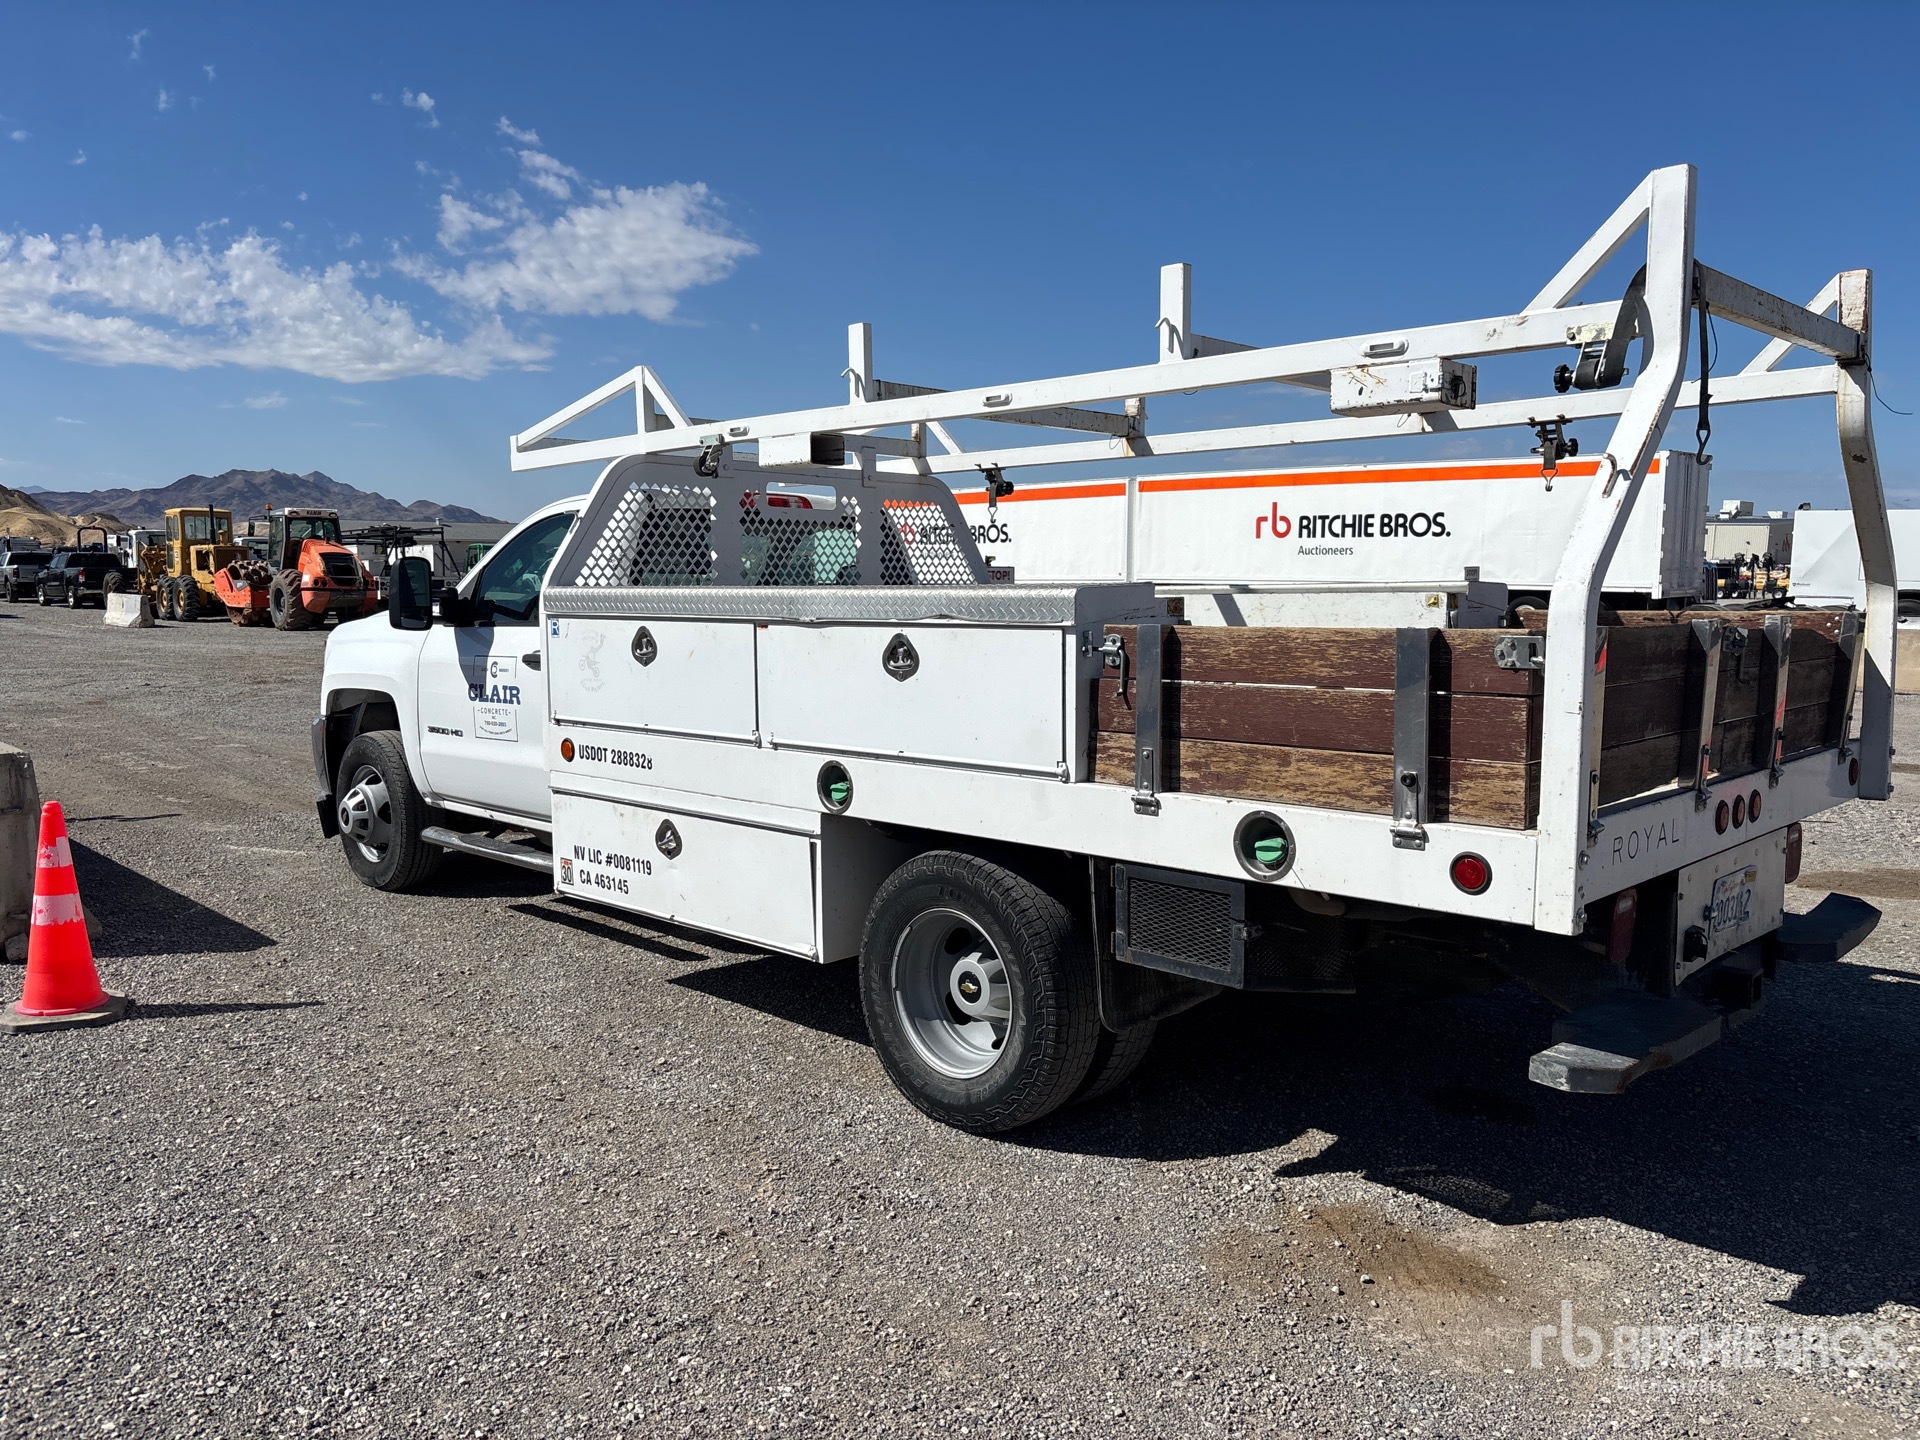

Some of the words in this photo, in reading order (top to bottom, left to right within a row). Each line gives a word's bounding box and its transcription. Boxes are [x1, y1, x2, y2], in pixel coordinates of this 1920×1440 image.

[1255, 501, 1292, 539] rb
[1298, 513, 1375, 539] RITCHIE
[1379, 511, 1452, 538] BROS.
[1298, 545, 1354, 556] Auctioneers
[988, 570, 1011, 580] TOP!
[468, 682, 521, 706] CLAIR
[450, 728, 464, 738] HD
[578, 743, 608, 763] USDOT
[1612, 818, 1680, 866] ROYAL
[573, 844, 586, 861] NV
[588, 847, 603, 865] LIC
[605, 852, 653, 876] #0081119
[562, 864, 572, 883] 30
[579, 868, 593, 886] CA
[594, 872, 630, 895] 463145
